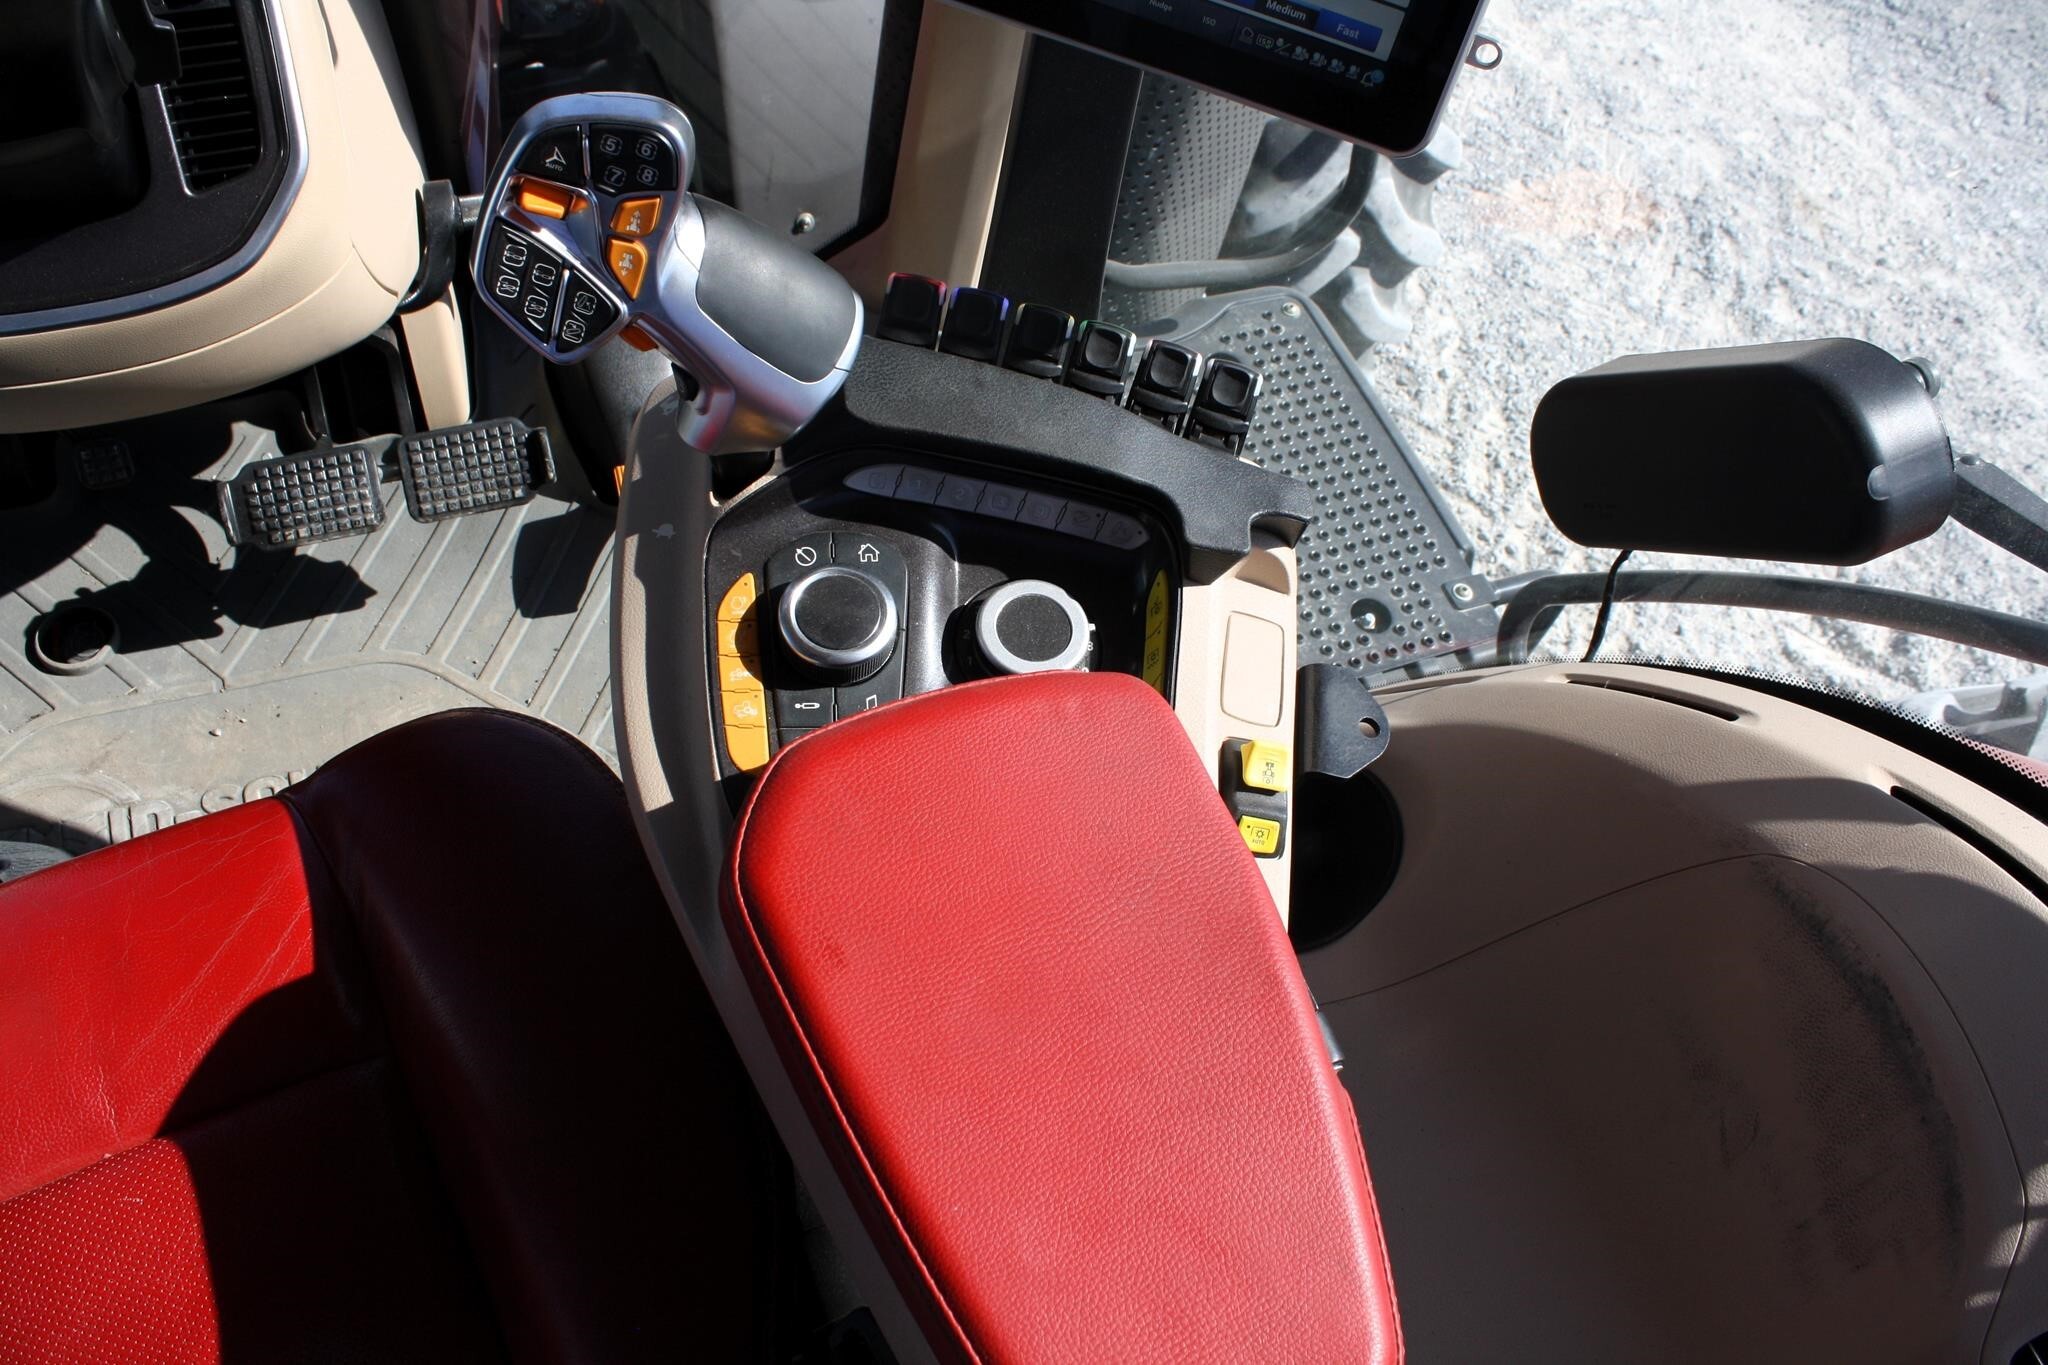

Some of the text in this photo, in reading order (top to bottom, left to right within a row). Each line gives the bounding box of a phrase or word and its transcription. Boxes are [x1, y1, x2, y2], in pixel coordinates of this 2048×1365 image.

[1265, 0, 1308, 21] Medium
[1336, 23, 1360, 40] Fast
[605, 138, 618, 151] 5
[640, 142, 652, 156] 6
[545, 162, 564, 172] AUTO
[610, 168, 622, 182] 7
[641, 168, 653, 183] 8
[1252, 838, 1265, 846] AUTO
